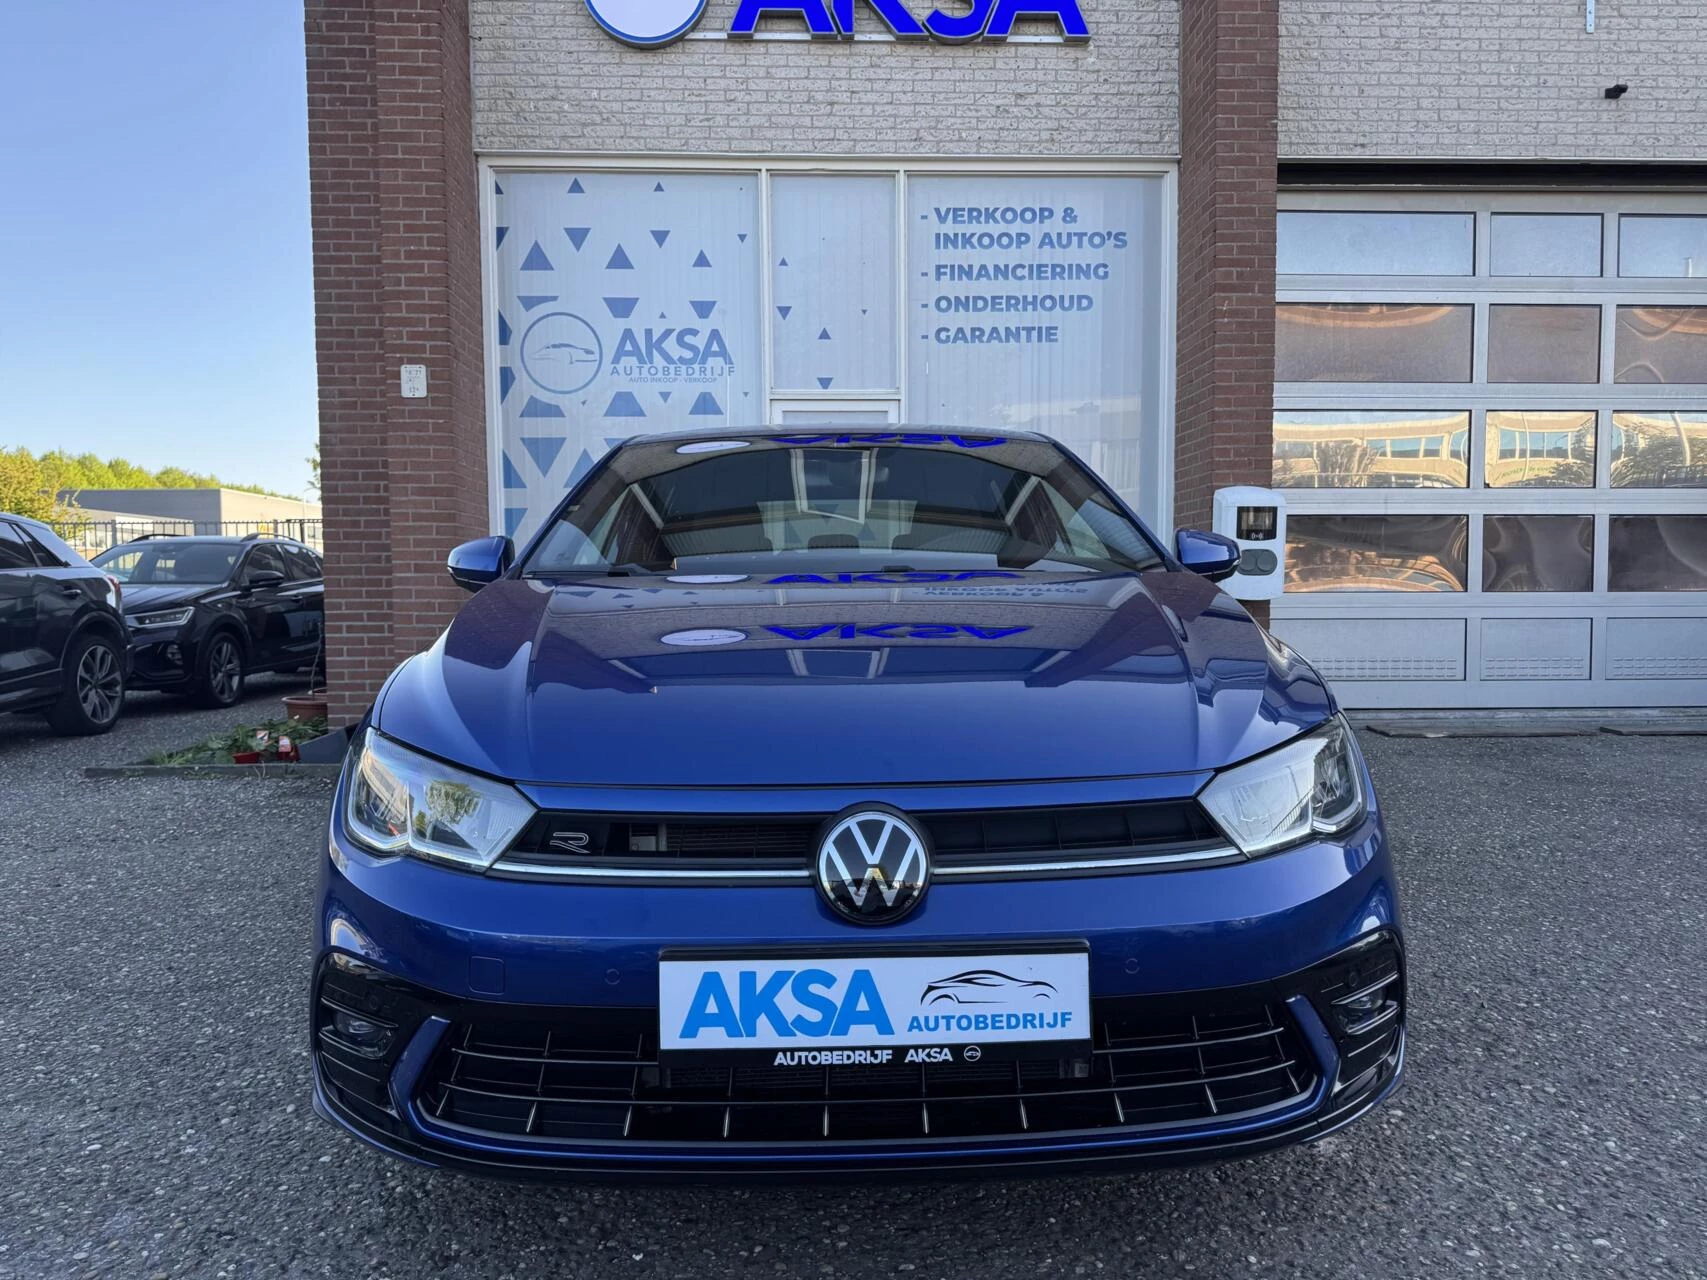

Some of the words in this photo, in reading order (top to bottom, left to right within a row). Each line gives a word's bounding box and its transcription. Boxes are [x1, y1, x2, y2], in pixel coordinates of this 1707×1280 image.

[933, 207, 1055, 225] VERKOOP
[1061, 207, 1079, 224] &
[934, 232, 1031, 250] INKOOP
[1037, 231, 1128, 249] AUTO'S
[934, 263, 1110, 281] FINANCIERING
[934, 294, 1094, 313] ONDERHOUD
[934, 326, 1059, 344] GARANTIE
[611, 328, 735, 365] AKSA
[610, 366, 735, 376] AUTOBEDRIJF
[549, 831, 591, 854] R
[678, 968, 895, 1039] AKSA
[907, 1011, 1073, 1033] AUTOBEDRIJF
[773, 1049, 893, 1066] AUTOBEDRIJF
[904, 1047, 953, 1063] AKSA
